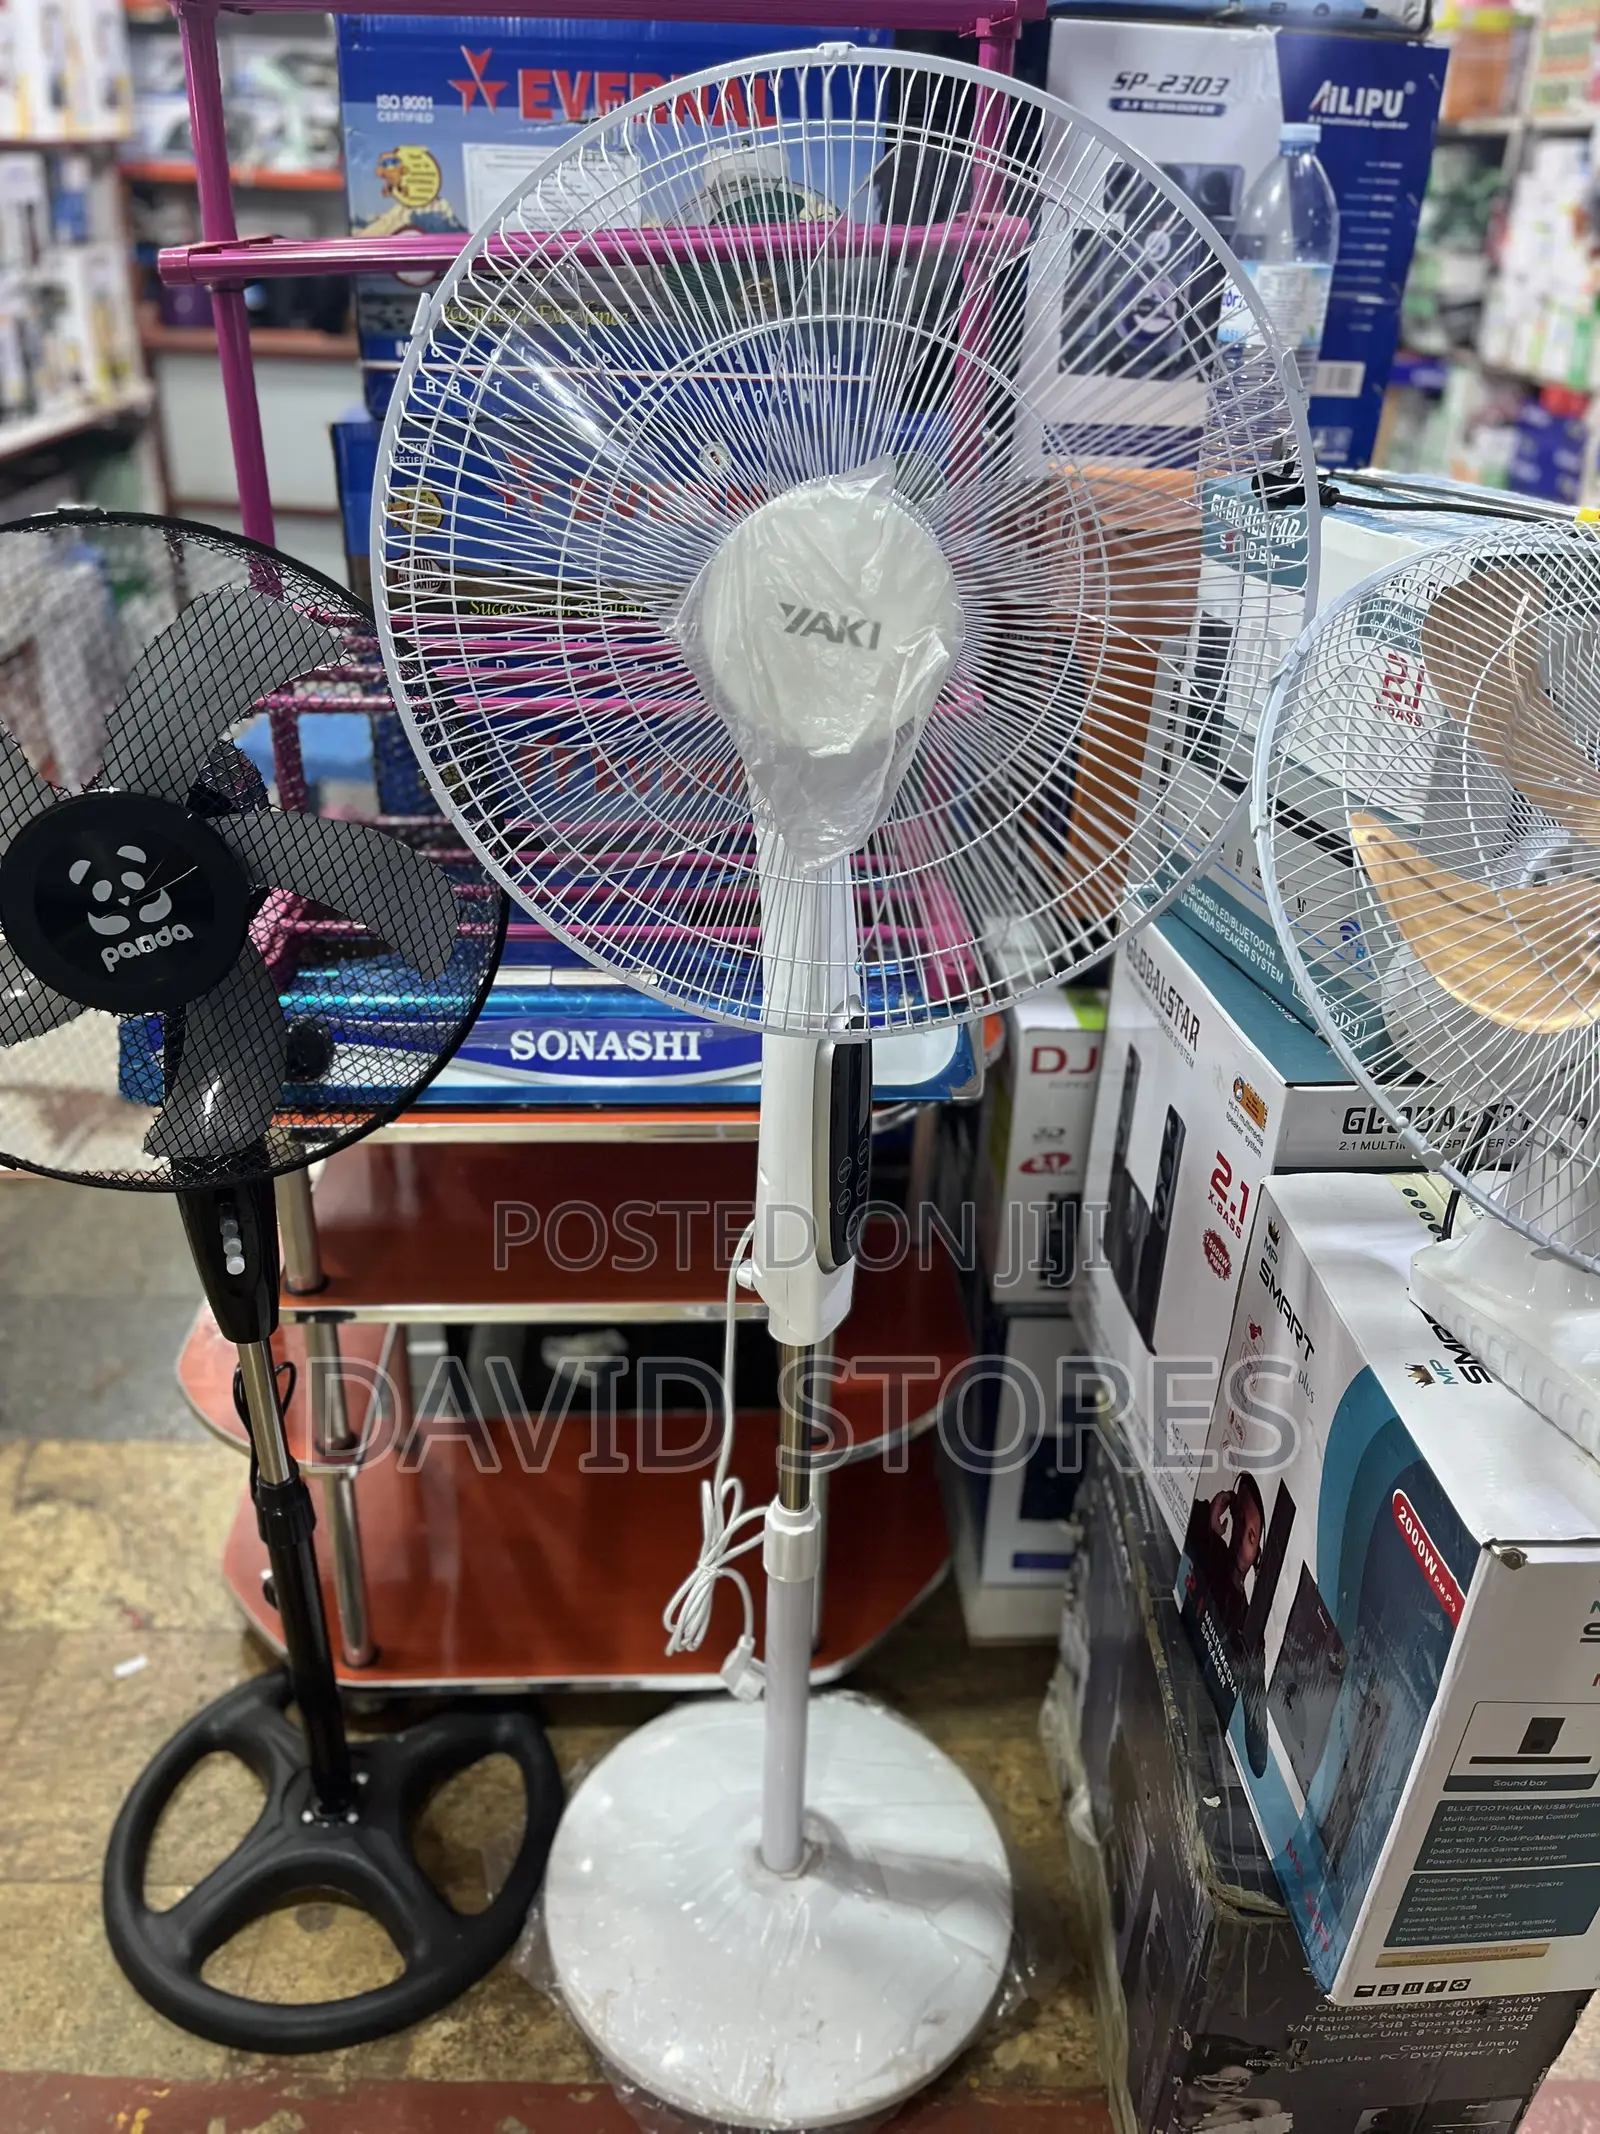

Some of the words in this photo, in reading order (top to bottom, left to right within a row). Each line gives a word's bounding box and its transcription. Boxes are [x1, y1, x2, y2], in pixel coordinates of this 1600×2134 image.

[1110, 71, 1230, 96] SP-2303
[376, 94, 399, 109] ISO
[402, 95, 433, 110] 9001
[376, 111, 434, 124] CERTIFIED
[470, 601, 530, 616] Success
[779, 602, 881, 650] YAKI
[100, 924, 194, 973] panda
[1180, 891, 1215, 930] ULTIMEDIA
[1214, 925, 1250, 962] SPEAKER
[1249, 952, 1285, 986] SYSTEM
[509, 1030, 703, 1062] SONASHI
[1244, 1134, 1262, 1159] system
[1339, 1139, 1357, 1151] 2.1
[1210, 1149, 1250, 1226] 2.1
[1207, 1189, 1242, 1240] X-BASS
[1205, 1236, 1229, 1269] 15000W
[1263, 1236, 1279, 1264] MP
[1259, 1257, 1315, 1362] SMART
[1429, 1358, 1459, 1385] MP
[1298, 1368, 1315, 1405] plus
[1397, 1505, 1438, 1577] 2000W
[1200, 1621, 1227, 1689] SPEAKER
[1204, 1609, 1238, 1699] MULTIMEDIA
[1493, 1779, 1528, 1787] Sound
[1529, 1779, 1548, 1787] bar
[1442, 1815, 1506, 1823] Multi-function
[1507, 1814, 1544, 1822] Remote
[1545, 1812, 1579, 1820] Control
[1457, 1824, 1489, 1833] Digital
[1489, 1824, 1525, 1832] Display
[1455, 1836, 1475, 1844] with
[1477, 1835, 1492, 1843] TV
[1425, 1857, 1470, 1866] Powerful
[1493, 1856, 1532, 1865] speaker
[1533, 1854, 1568, 1863] system
[1418, 1877, 1449, 1885] Output
[1402, 1917, 1439, 1925] Speaker
[1286, 2024, 1312, 2032] S/N
[1304, 2014, 1377, 2022] Frequency
[1323, 2032, 1377, 2042] Speaker
[1409, 2050, 1442, 2060] DVD
[1444, 2047, 1486, 2057] Player
[1497, 2046, 1517, 2055] TV
